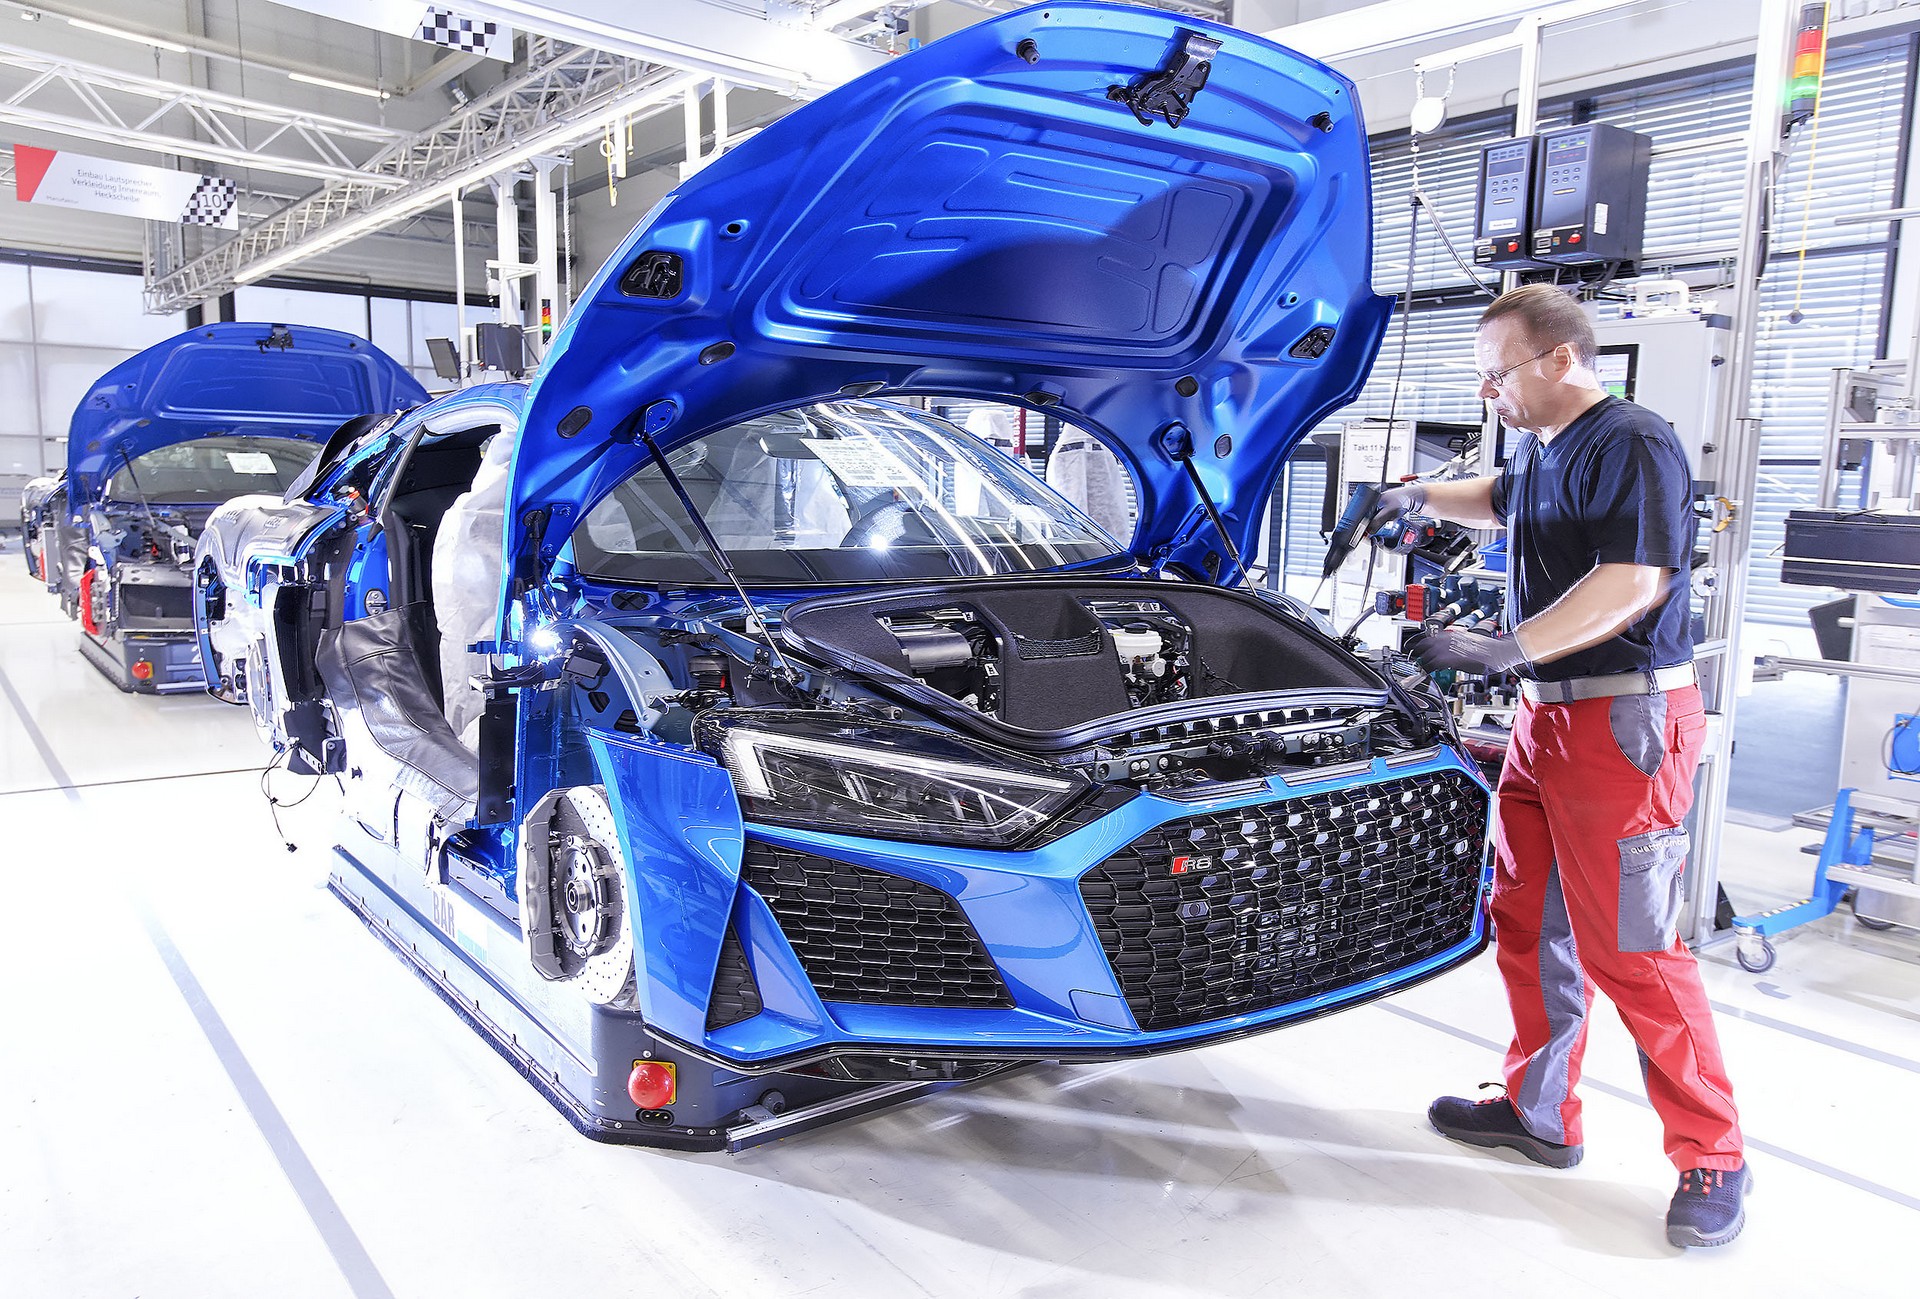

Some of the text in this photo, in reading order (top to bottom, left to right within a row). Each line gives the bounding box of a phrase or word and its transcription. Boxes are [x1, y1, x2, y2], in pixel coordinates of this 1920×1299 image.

[77, 169, 104, 180] Einbau
[72, 178, 117, 192] Verkleidung
[95, 190, 141, 203] Heckscheibe
[202, 194, 222, 208] 10
[1630, 841, 1663, 854] quattro
[1180, 857, 1212, 871] R8
[433, 891, 455, 938] BÄR
